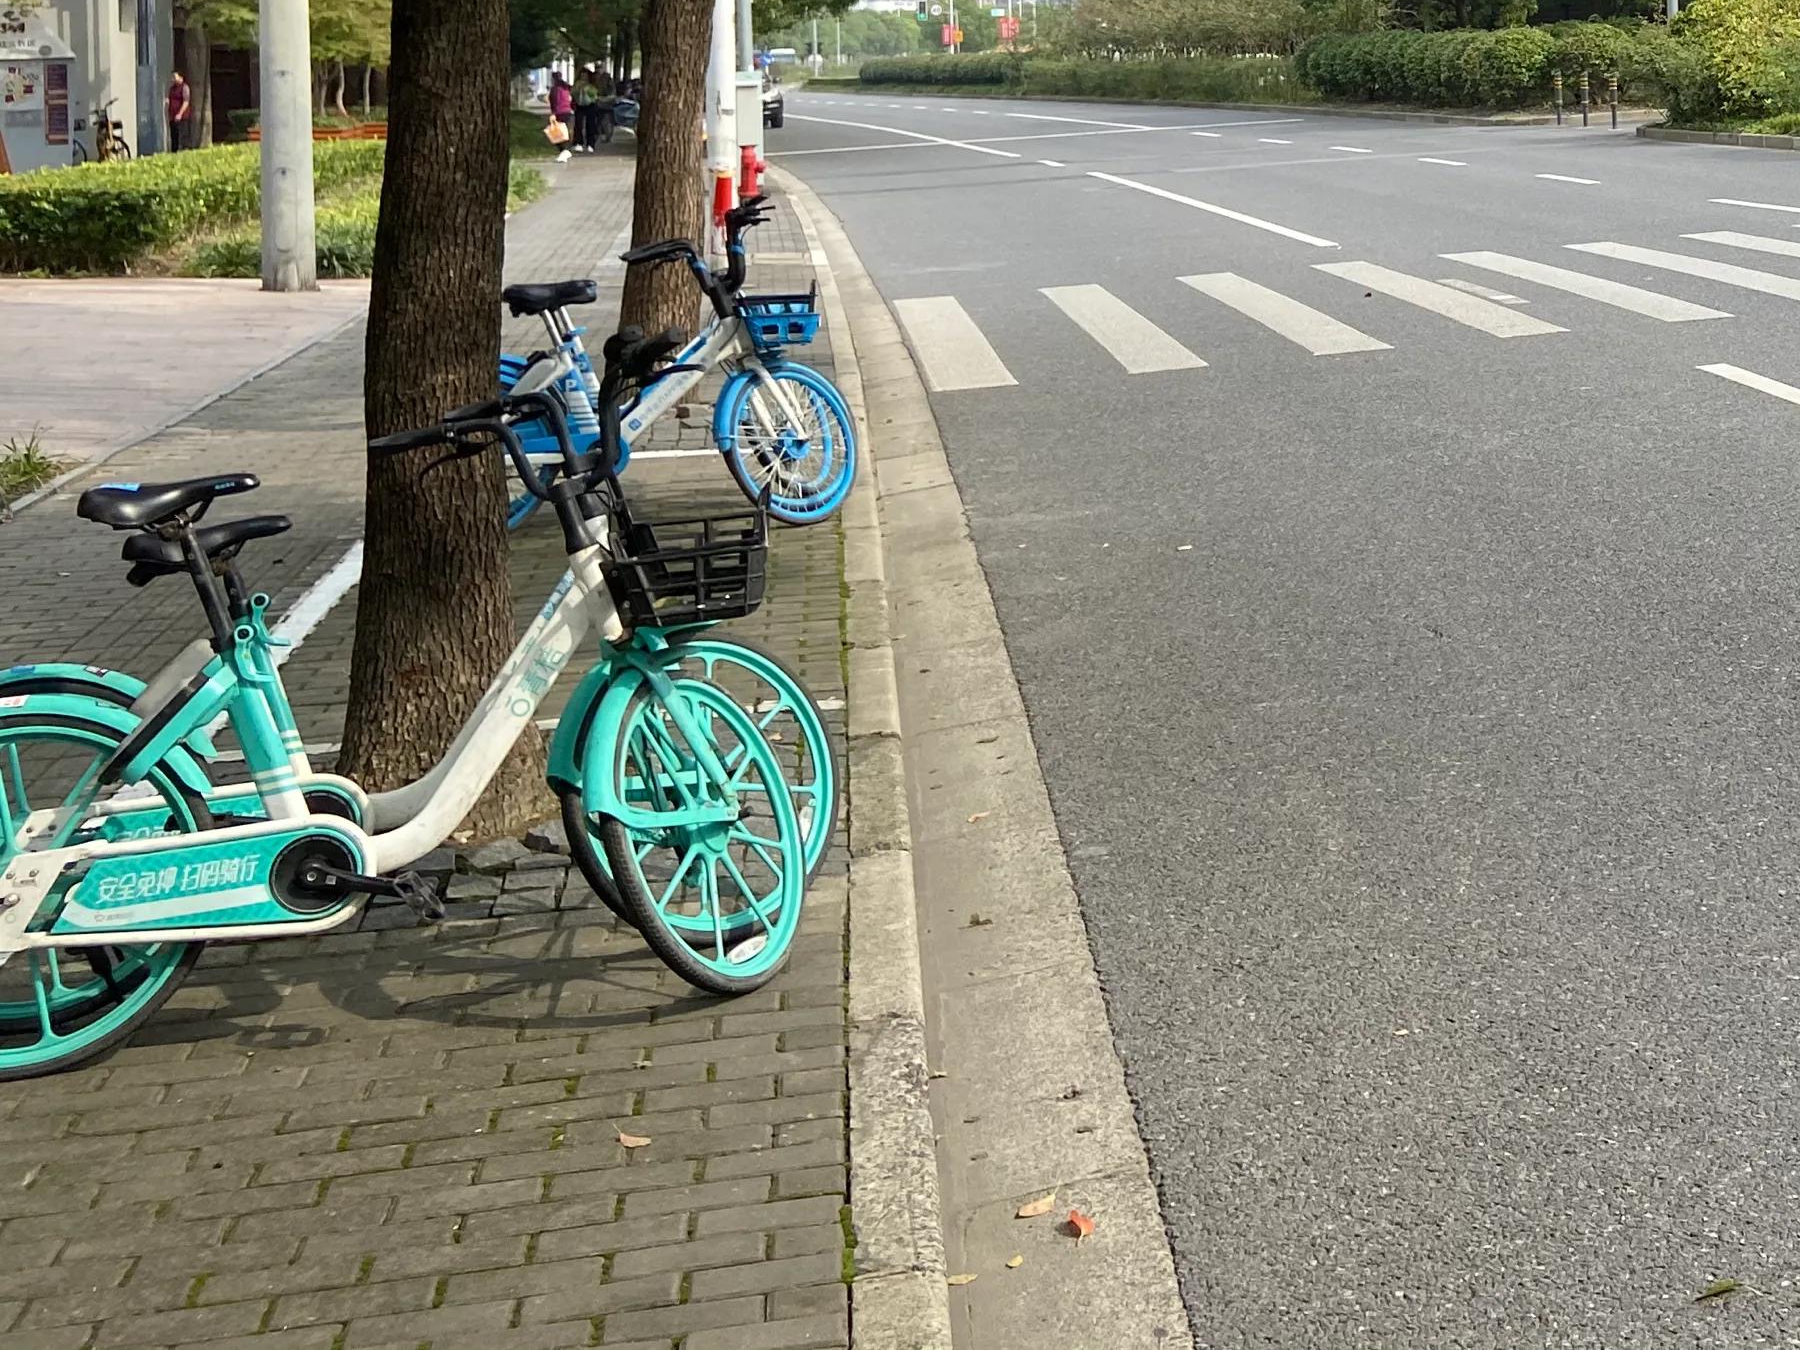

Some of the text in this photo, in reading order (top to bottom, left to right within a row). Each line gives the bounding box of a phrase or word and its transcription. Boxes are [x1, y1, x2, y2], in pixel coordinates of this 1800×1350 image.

[96, 853, 261, 904] 安全免押 扫码骑行
